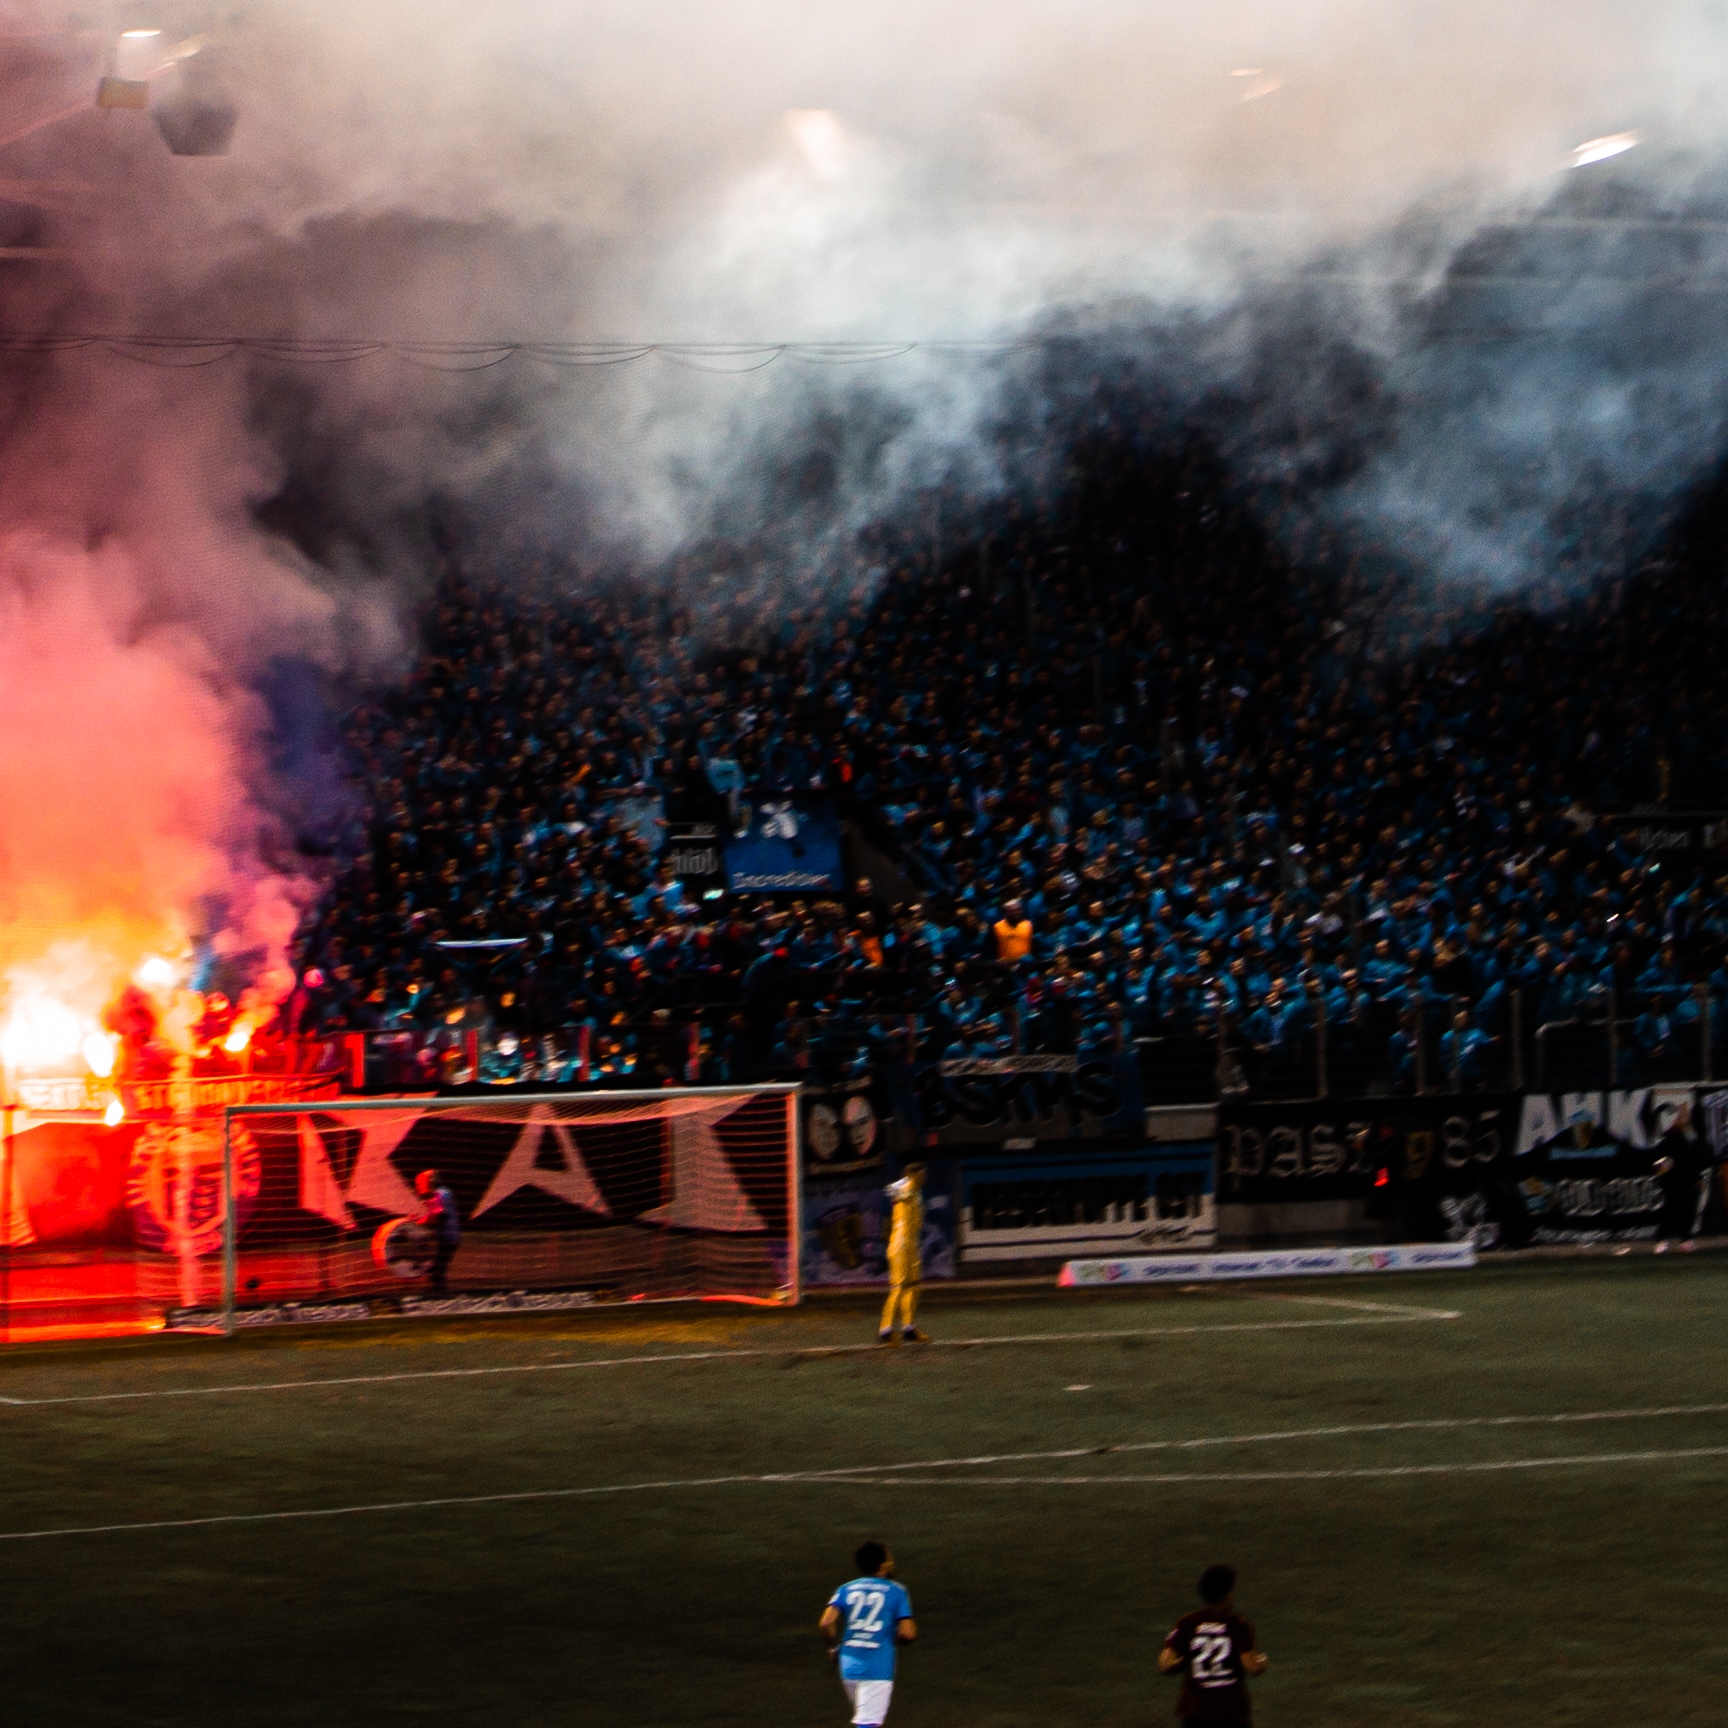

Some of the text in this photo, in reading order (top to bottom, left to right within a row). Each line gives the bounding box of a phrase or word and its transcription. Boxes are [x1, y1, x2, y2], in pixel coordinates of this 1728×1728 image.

[1440, 1108, 1503, 1168] 85
[845, 1590, 886, 1632] 22
[1190, 1635, 1235, 1679] 22
